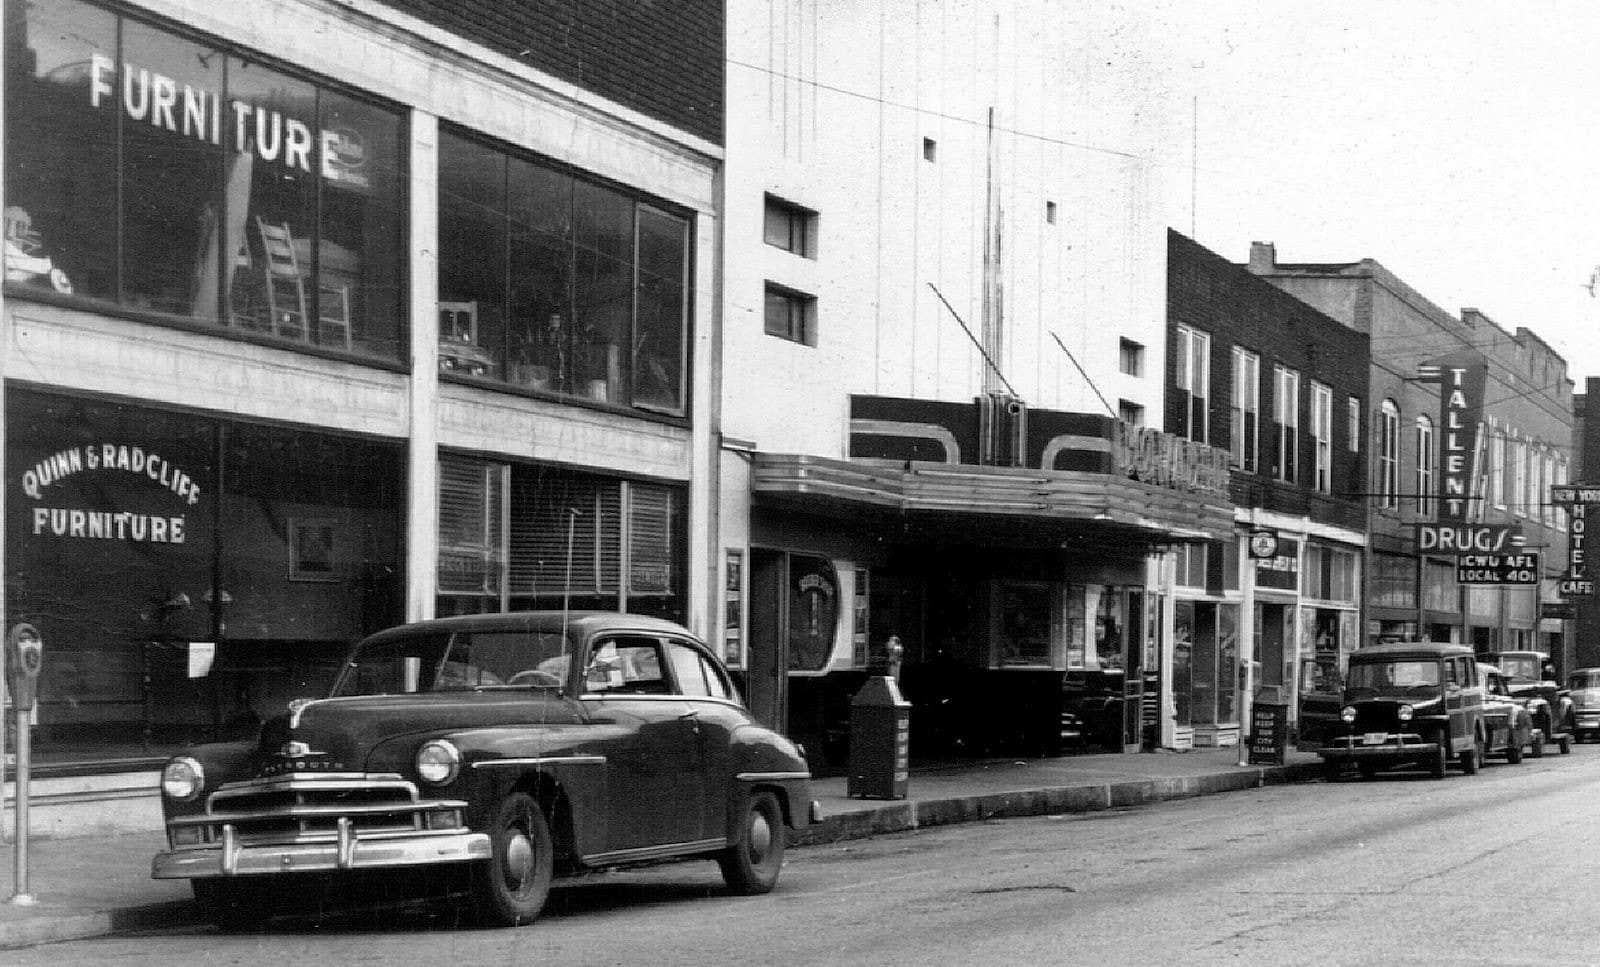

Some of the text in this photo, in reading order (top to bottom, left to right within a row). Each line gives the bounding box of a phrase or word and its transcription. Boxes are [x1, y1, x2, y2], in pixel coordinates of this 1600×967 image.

[91, 53, 341, 180] FURNITURE
[1446, 368, 1467, 516] TALLENT
[23, 443, 200, 504] QUINN & RADCLIFF
[33, 507, 185, 543] FURNITURE
[1420, 527, 1508, 551] DRUGS
[1571, 504, 1585, 578] HOTEL
[1460, 569, 1500, 581] LOCAL
[1506, 555, 1534, 567] AFL
[1562, 581, 1594, 594] CAFE
